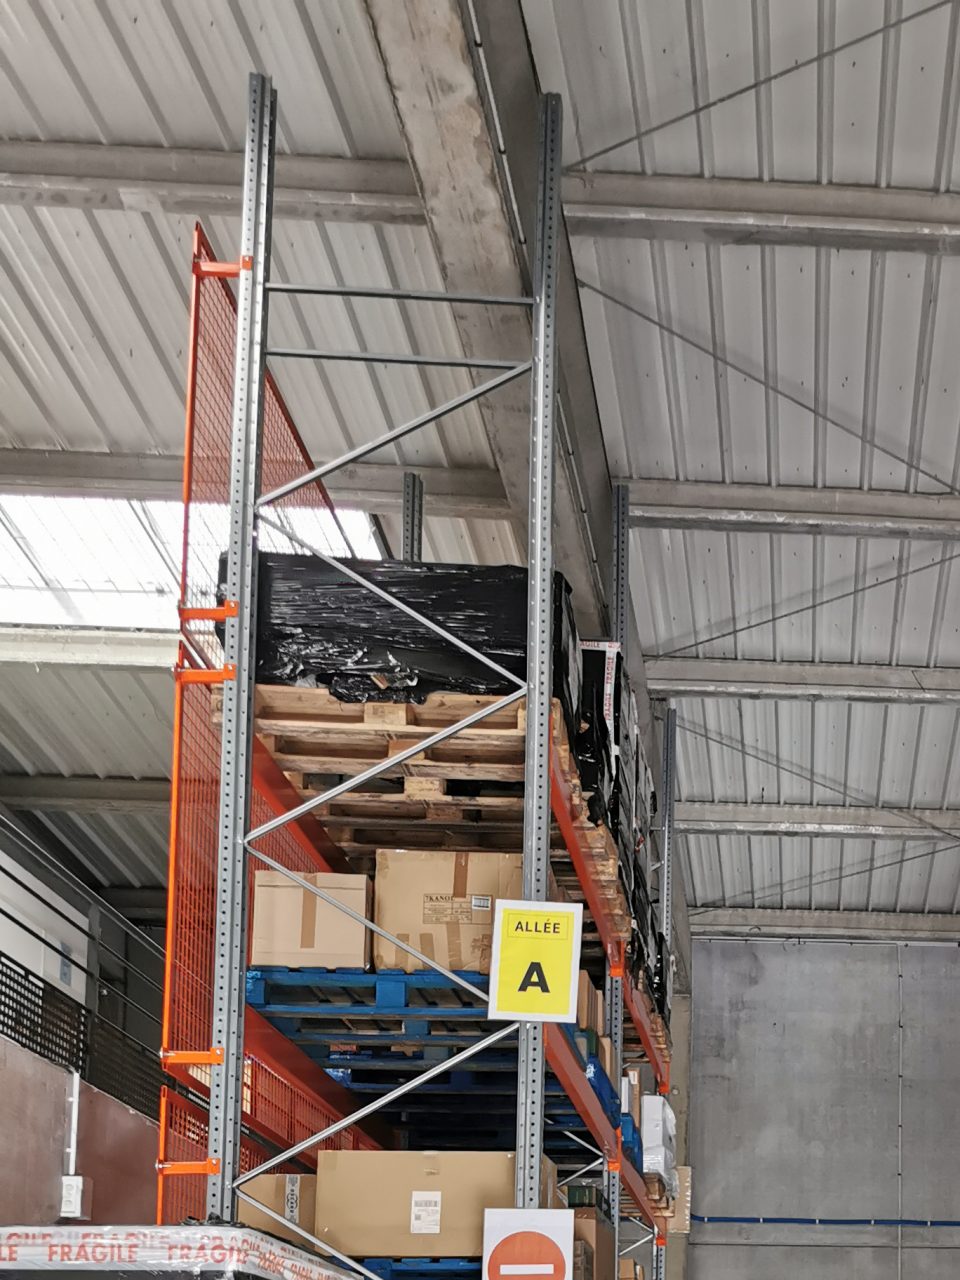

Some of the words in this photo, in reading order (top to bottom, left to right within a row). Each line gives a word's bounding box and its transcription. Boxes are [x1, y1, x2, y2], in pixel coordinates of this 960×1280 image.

[514, 918, 561, 934] ALLÉE
[517, 961, 551, 994] A
[47, 1243, 140, 1264] FRAGILE
